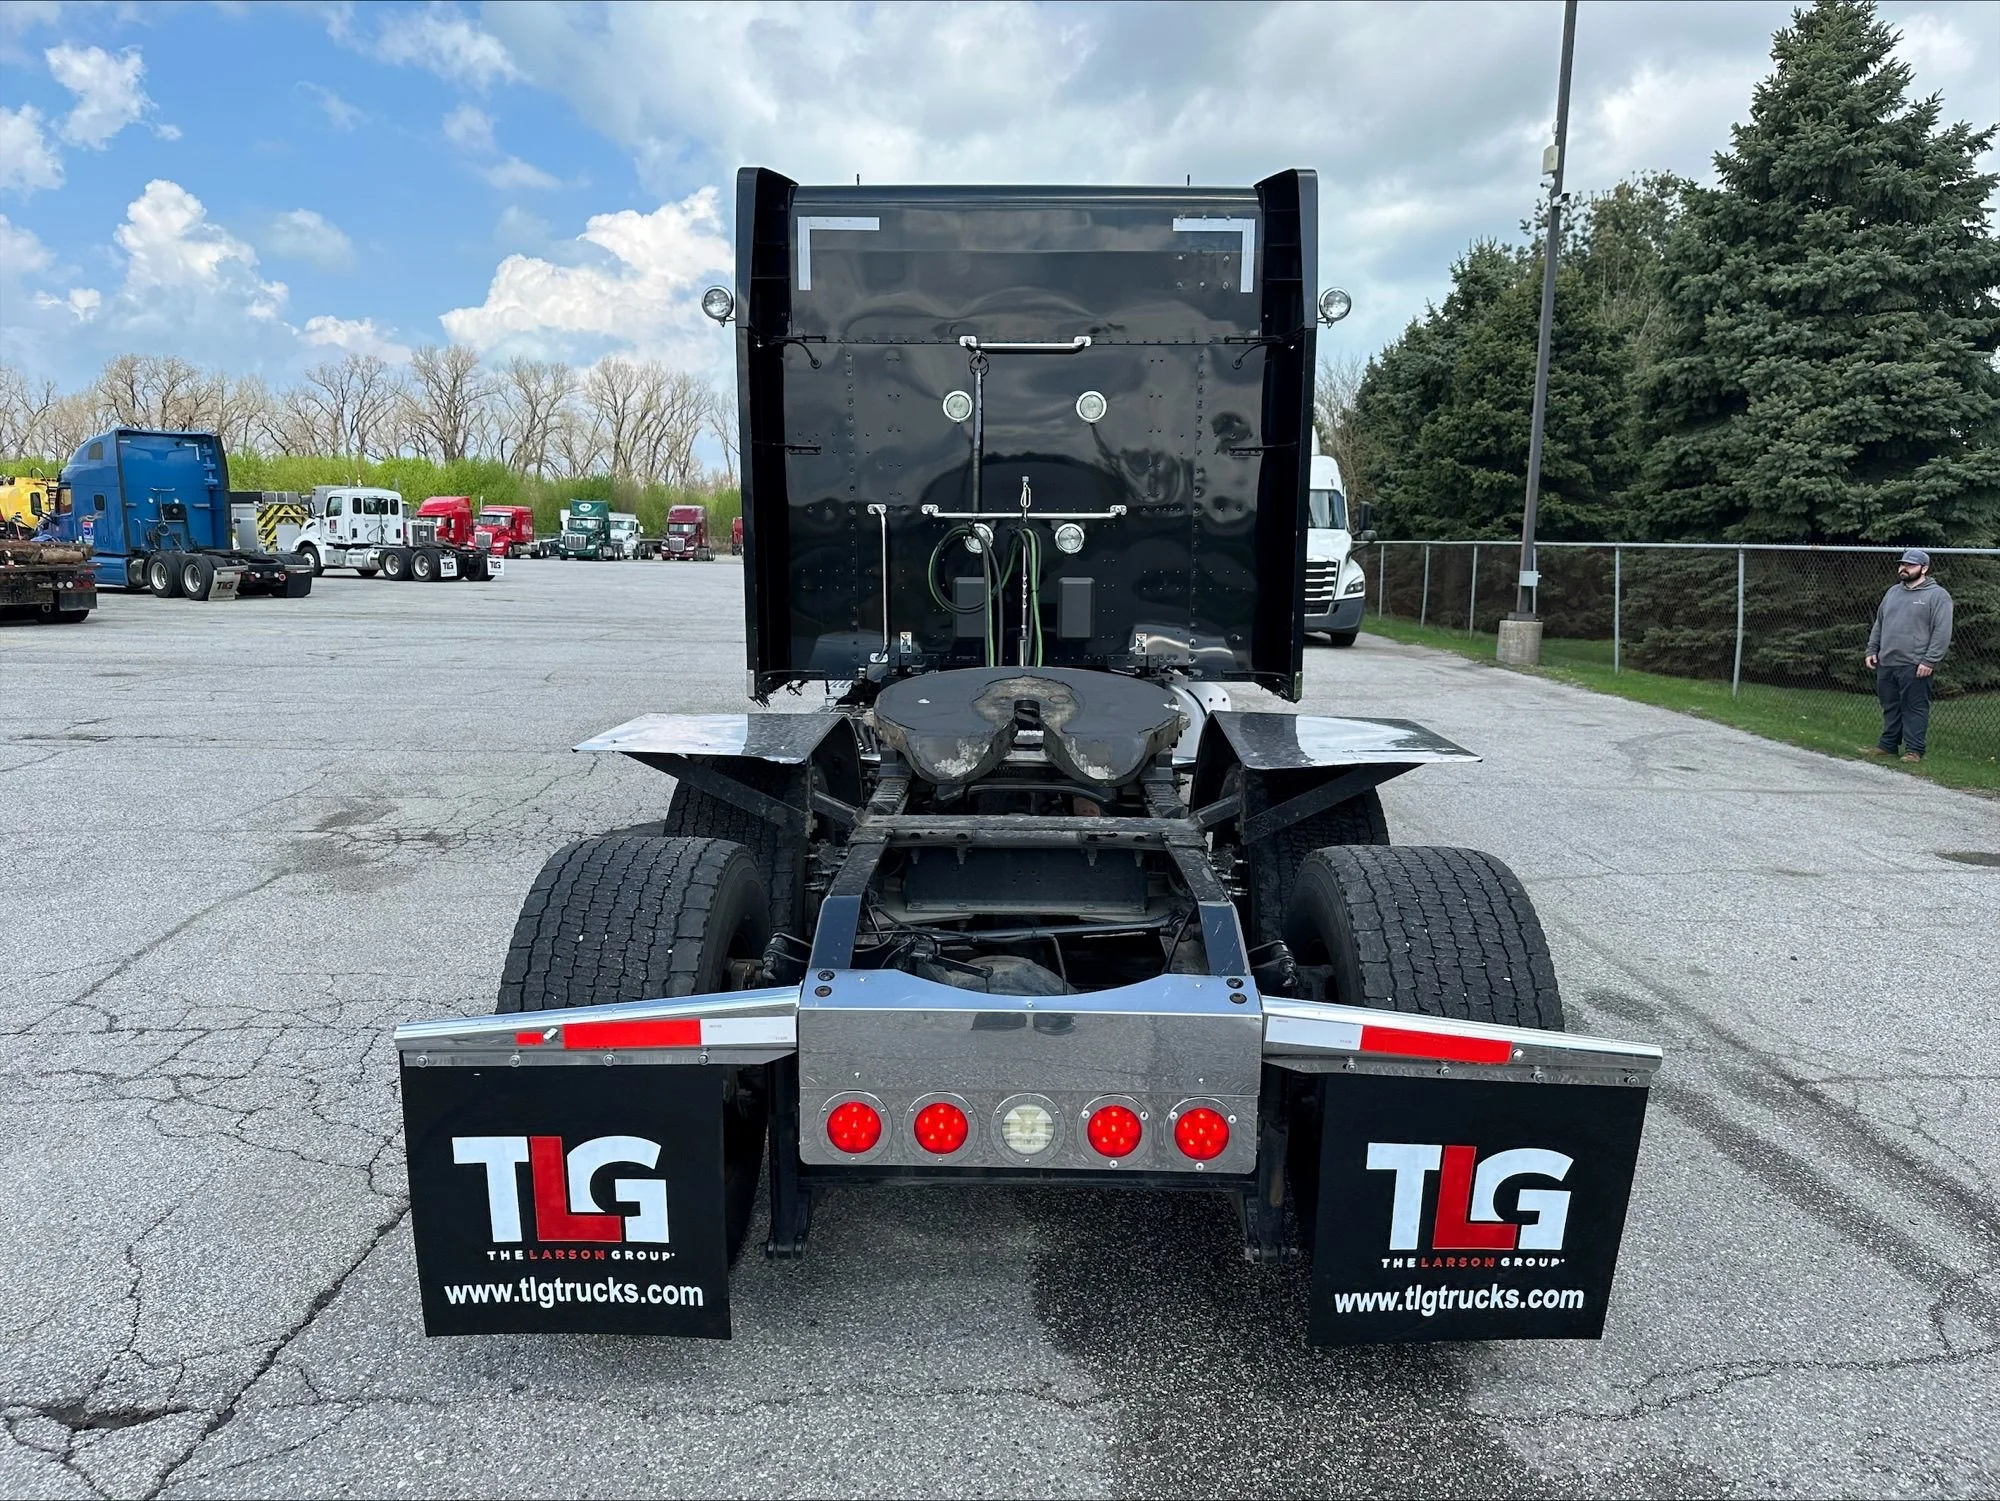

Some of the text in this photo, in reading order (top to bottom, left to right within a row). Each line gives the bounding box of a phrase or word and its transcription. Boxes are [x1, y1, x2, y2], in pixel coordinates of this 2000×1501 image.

[452, 1136, 669, 1243] TLG
[1366, 1142, 1574, 1250] TLG
[487, 1250, 524, 1261] THE
[529, 1250, 605, 1260] LARSON
[1382, 1258, 1417, 1268] THE
[1422, 1258, 1495, 1268] LARSON
[444, 1277, 704, 1308] www.tlgtrucks.com
[1335, 1284, 1584, 1316] www.tlgtrucks.com
